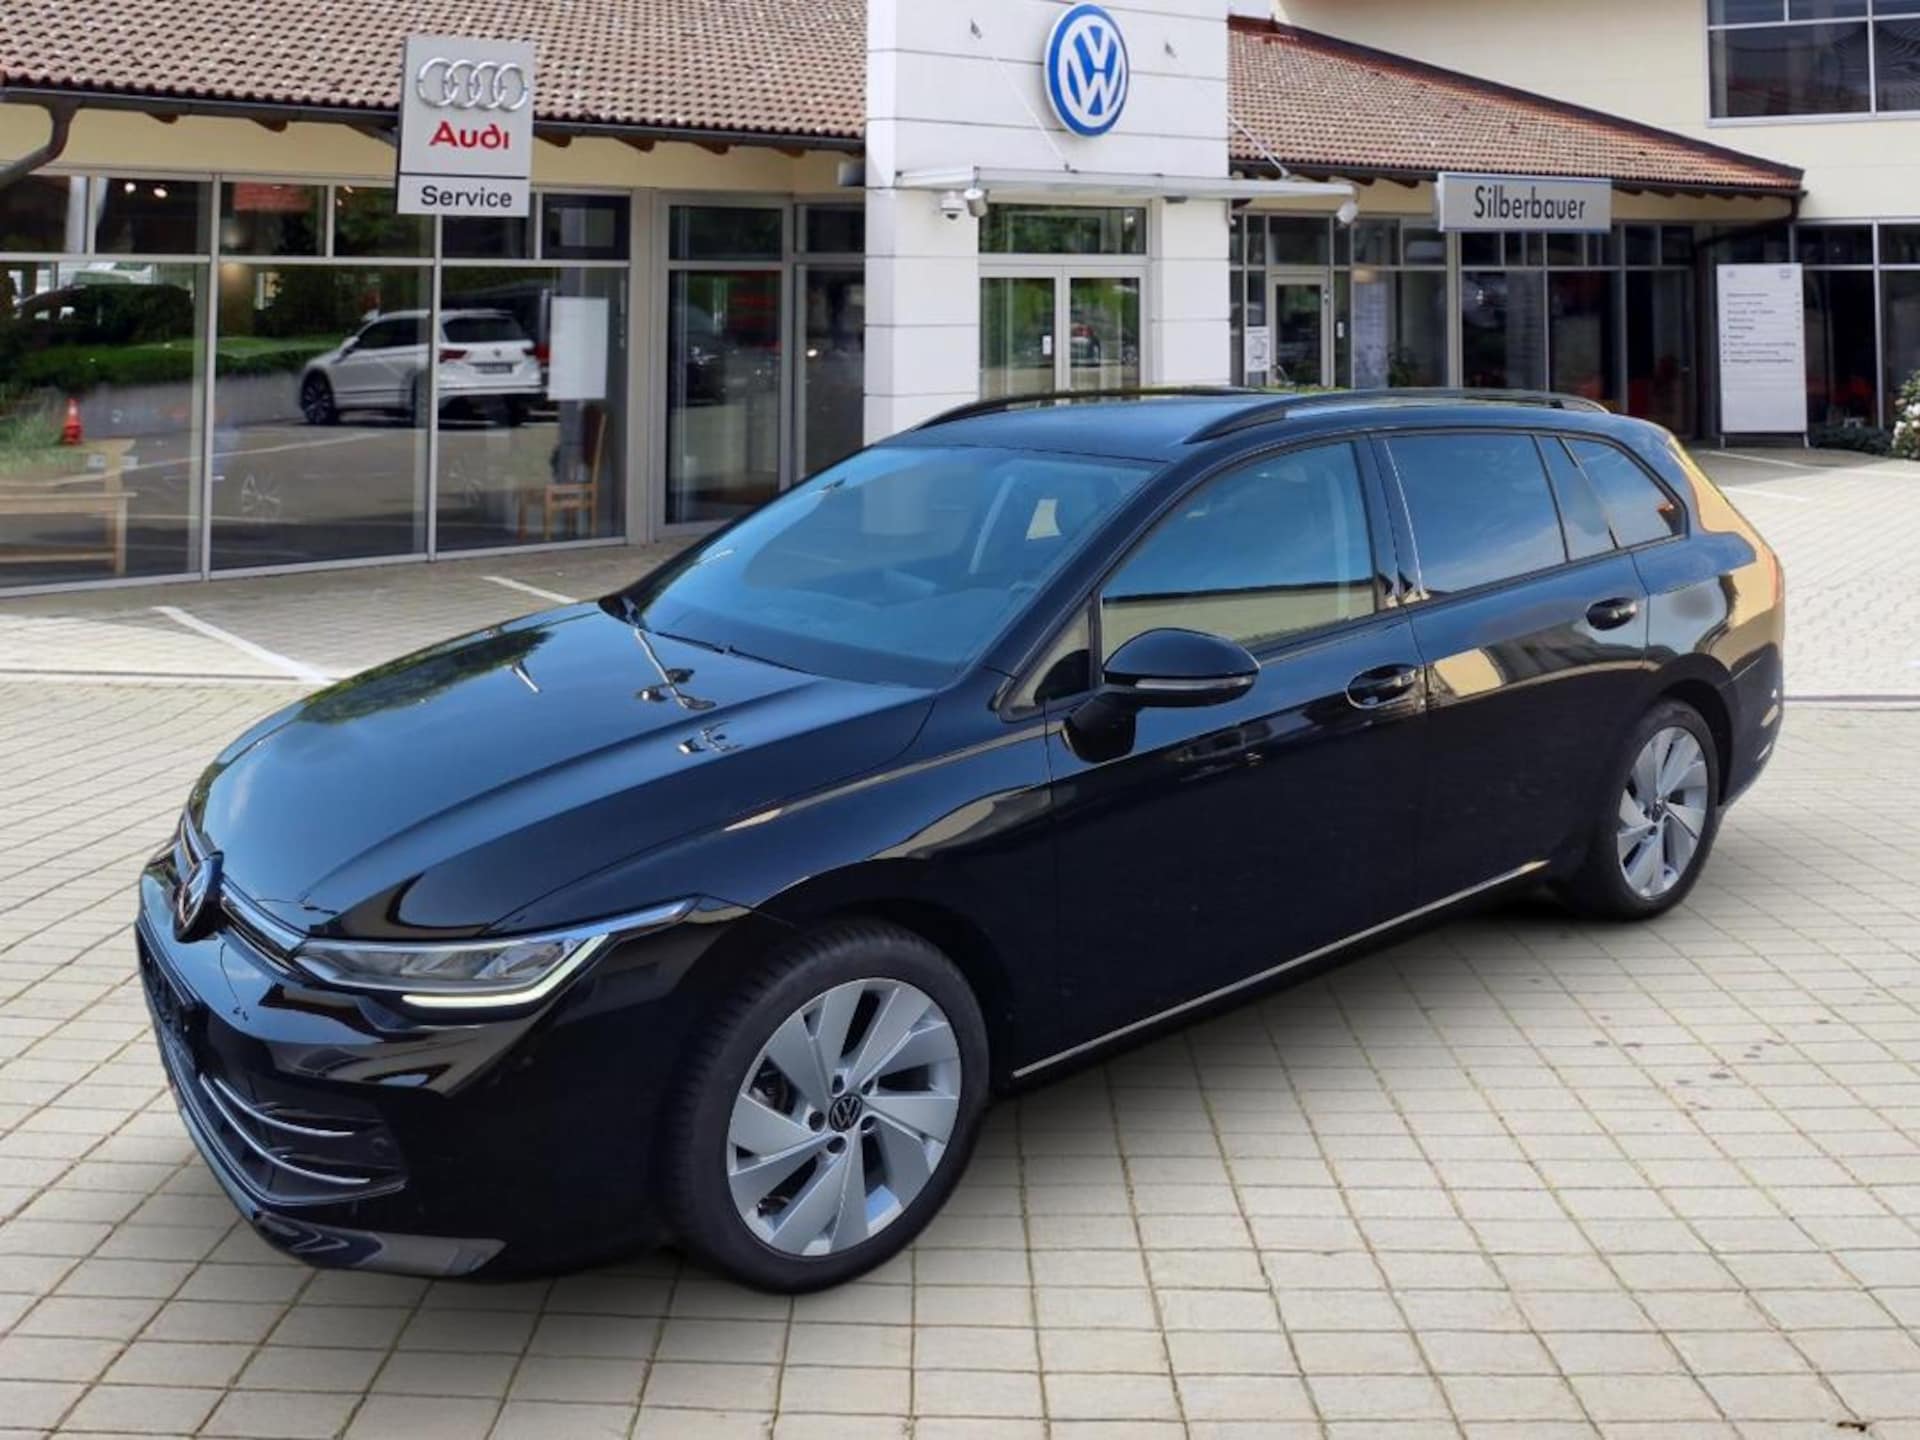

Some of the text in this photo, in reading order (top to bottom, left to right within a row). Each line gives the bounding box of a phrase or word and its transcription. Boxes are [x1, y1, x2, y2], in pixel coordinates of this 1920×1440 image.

[1057, 15, 1122, 124] VW
[429, 120, 510, 149] Audi
[420, 184, 513, 208] Service
[1473, 184, 1585, 220] Silberbauer
